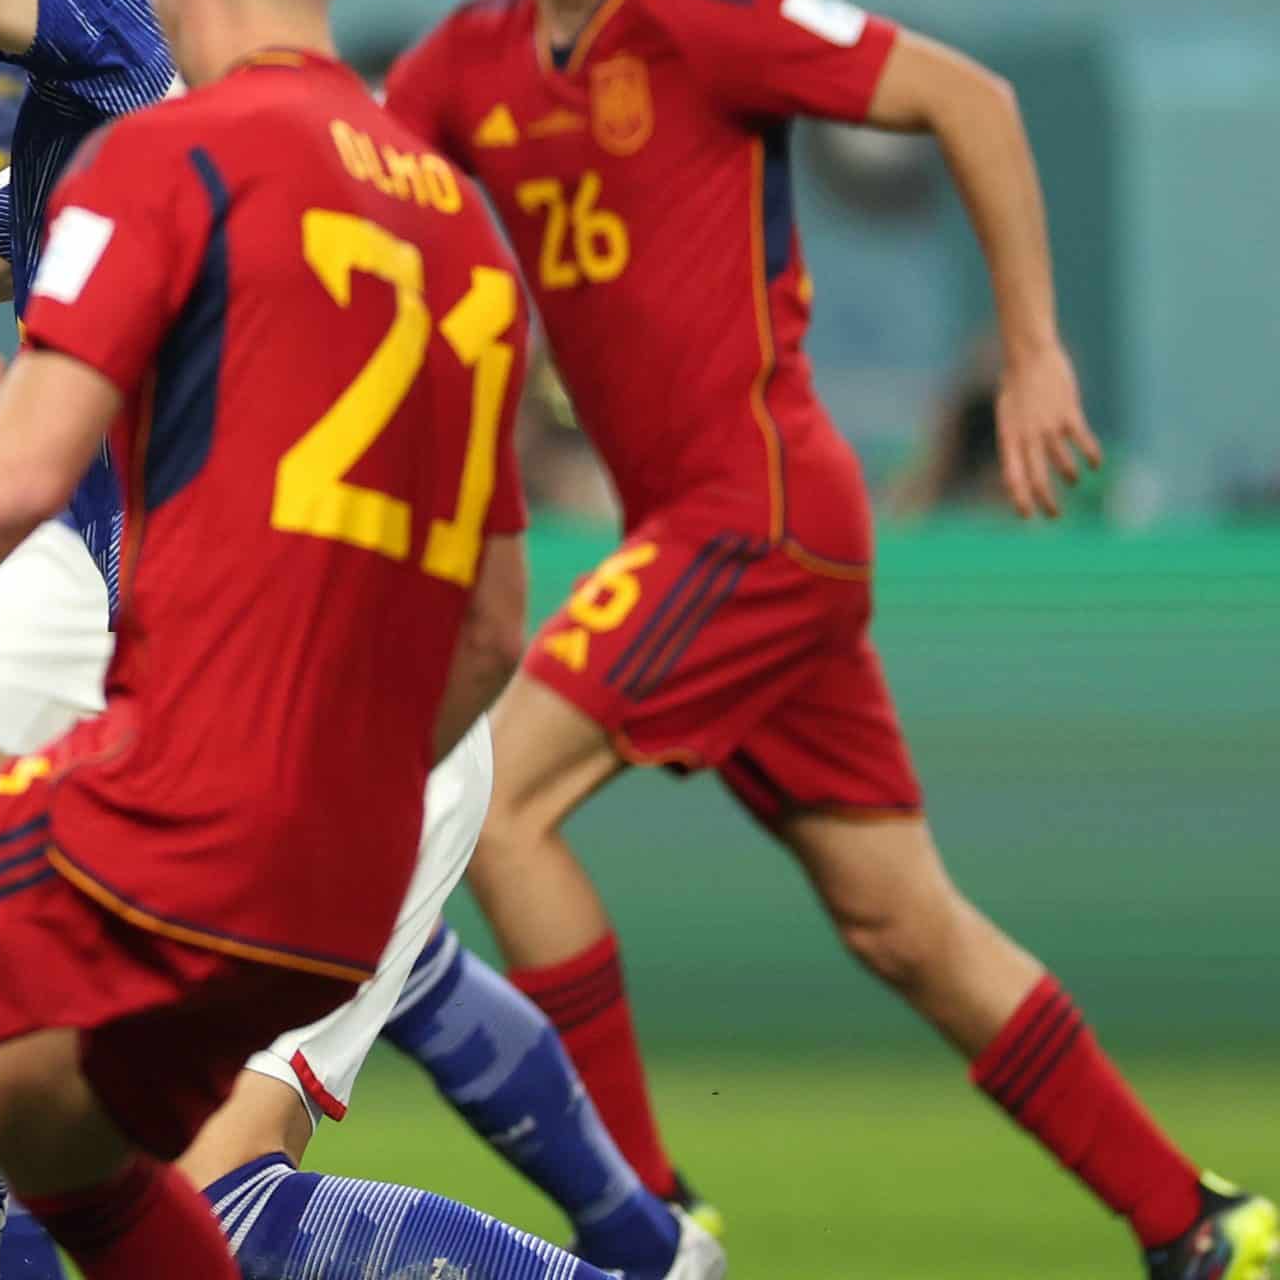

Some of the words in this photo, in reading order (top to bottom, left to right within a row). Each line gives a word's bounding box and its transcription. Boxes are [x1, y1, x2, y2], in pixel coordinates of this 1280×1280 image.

[329, 119, 464, 215] OLMO
[517, 171, 630, 289] 26
[270, 206, 518, 589] 21
